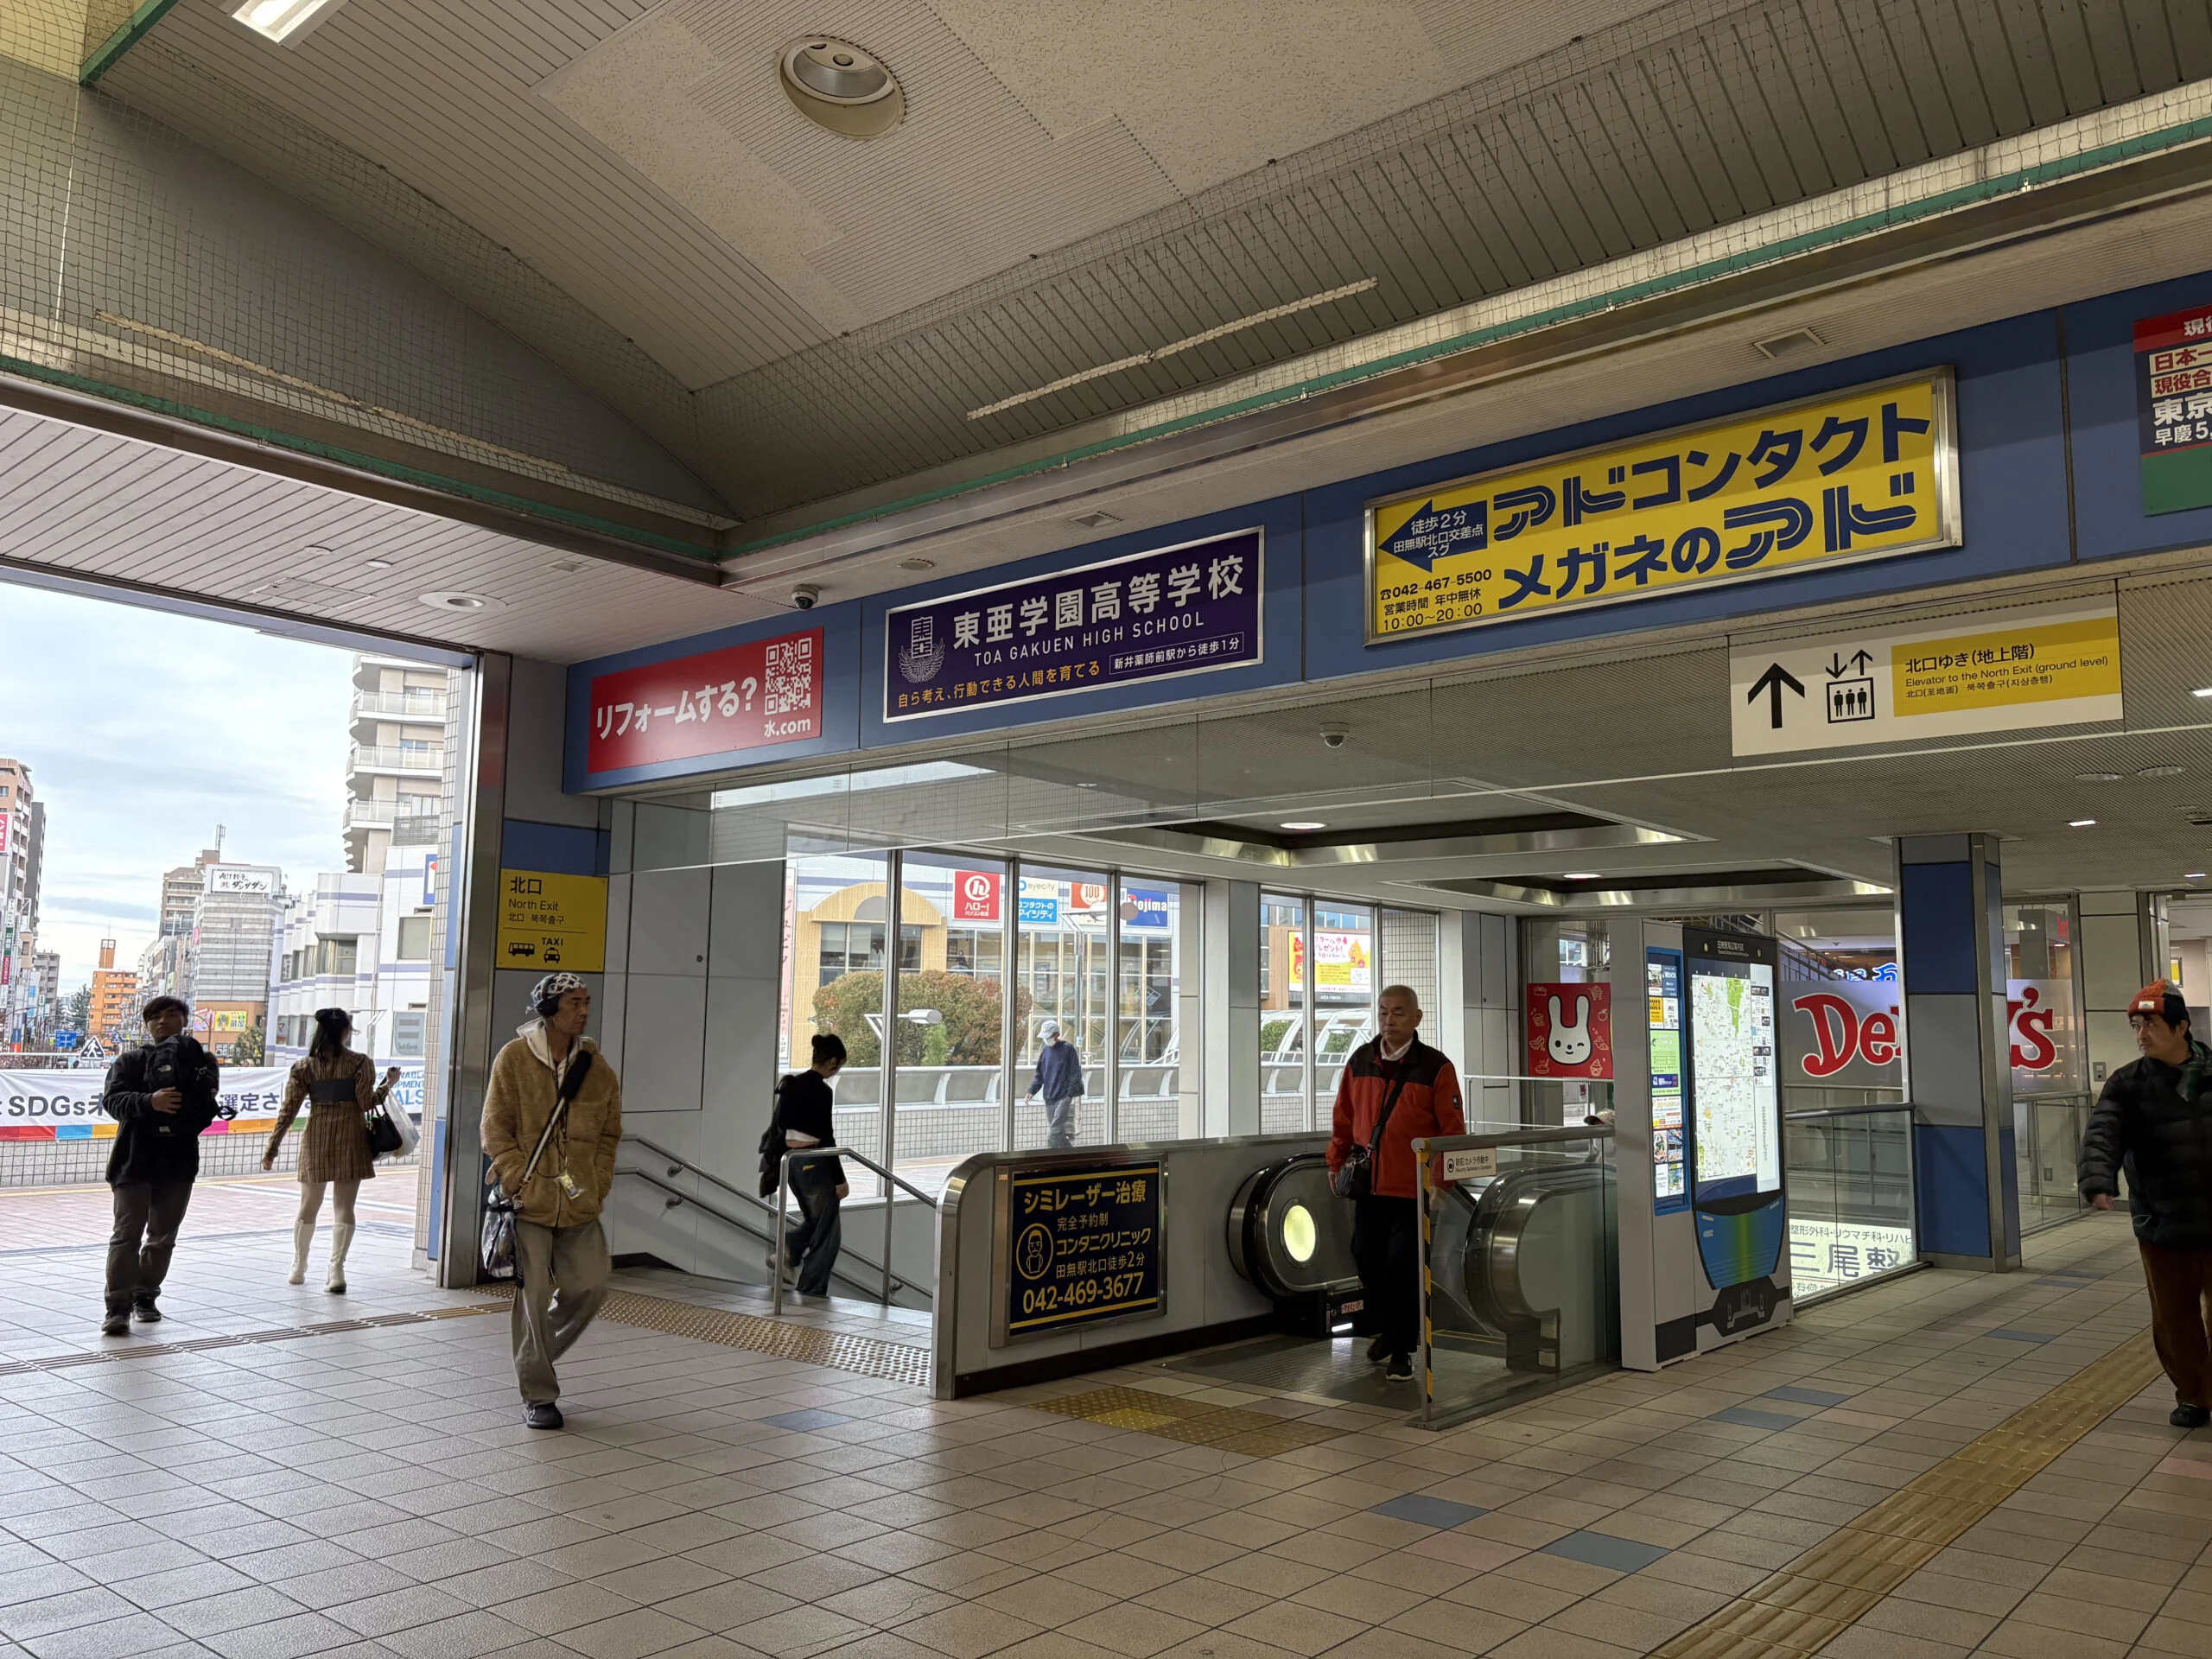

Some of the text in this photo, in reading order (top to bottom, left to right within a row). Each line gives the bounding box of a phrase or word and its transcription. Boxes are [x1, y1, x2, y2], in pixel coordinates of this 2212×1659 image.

[2154, 369, 2212, 395] 現役合
[2152, 392, 2212, 426] 東京
[1493, 402, 1930, 542] アドコンタクト
[1411, 510, 1467, 536] 徒歩2分
[1393, 524, 1484, 554] 田無駅北口交差点
[1427, 543, 1450, 558] スグ
[1498, 471, 1917, 608] メガネのアド
[1393, 569, 1492, 598] 042-467-5500
[953, 555, 1243, 650] 東亜学園高等学校
[1383, 588, 1481, 616] 営業時間 年中無休
[974, 612, 1205, 667] TOA GAKUEN HIGH SCHOOL
[1114, 637, 1240, 670] 新井薬師前駅から徒歩1分
[1905, 643, 2035, 673] 北口ゆき(地上階)
[1905, 656, 2108, 687] Elevator to the North Exit (ground level)
[898, 660, 1100, 708] 自ら考え、行動できる人間を育てる
[1905, 684, 1959, 698] 北口(至地面)
[596, 677, 758, 740] リフォームする?
[764, 718, 811, 737] 水.com
[510, 875, 543, 895] 北口
[1027, 882, 1055, 892] eyecity
[1084, 885, 1100, 899] 100
[508, 898, 559, 912] North Exit
[508, 912, 524, 922] 北口
[541, 937, 564, 947] TAXI
[1023, 1179, 1147, 1214] シミレーザー治療
[1056, 1211, 1109, 1232] 完全予約制
[1056, 1227, 1152, 1256] コンタニクリニック
[1056, 1251, 1146, 1280] 田無駅北口徒歩2分
[1022, 1271, 1145, 1314] 042-469-3677
